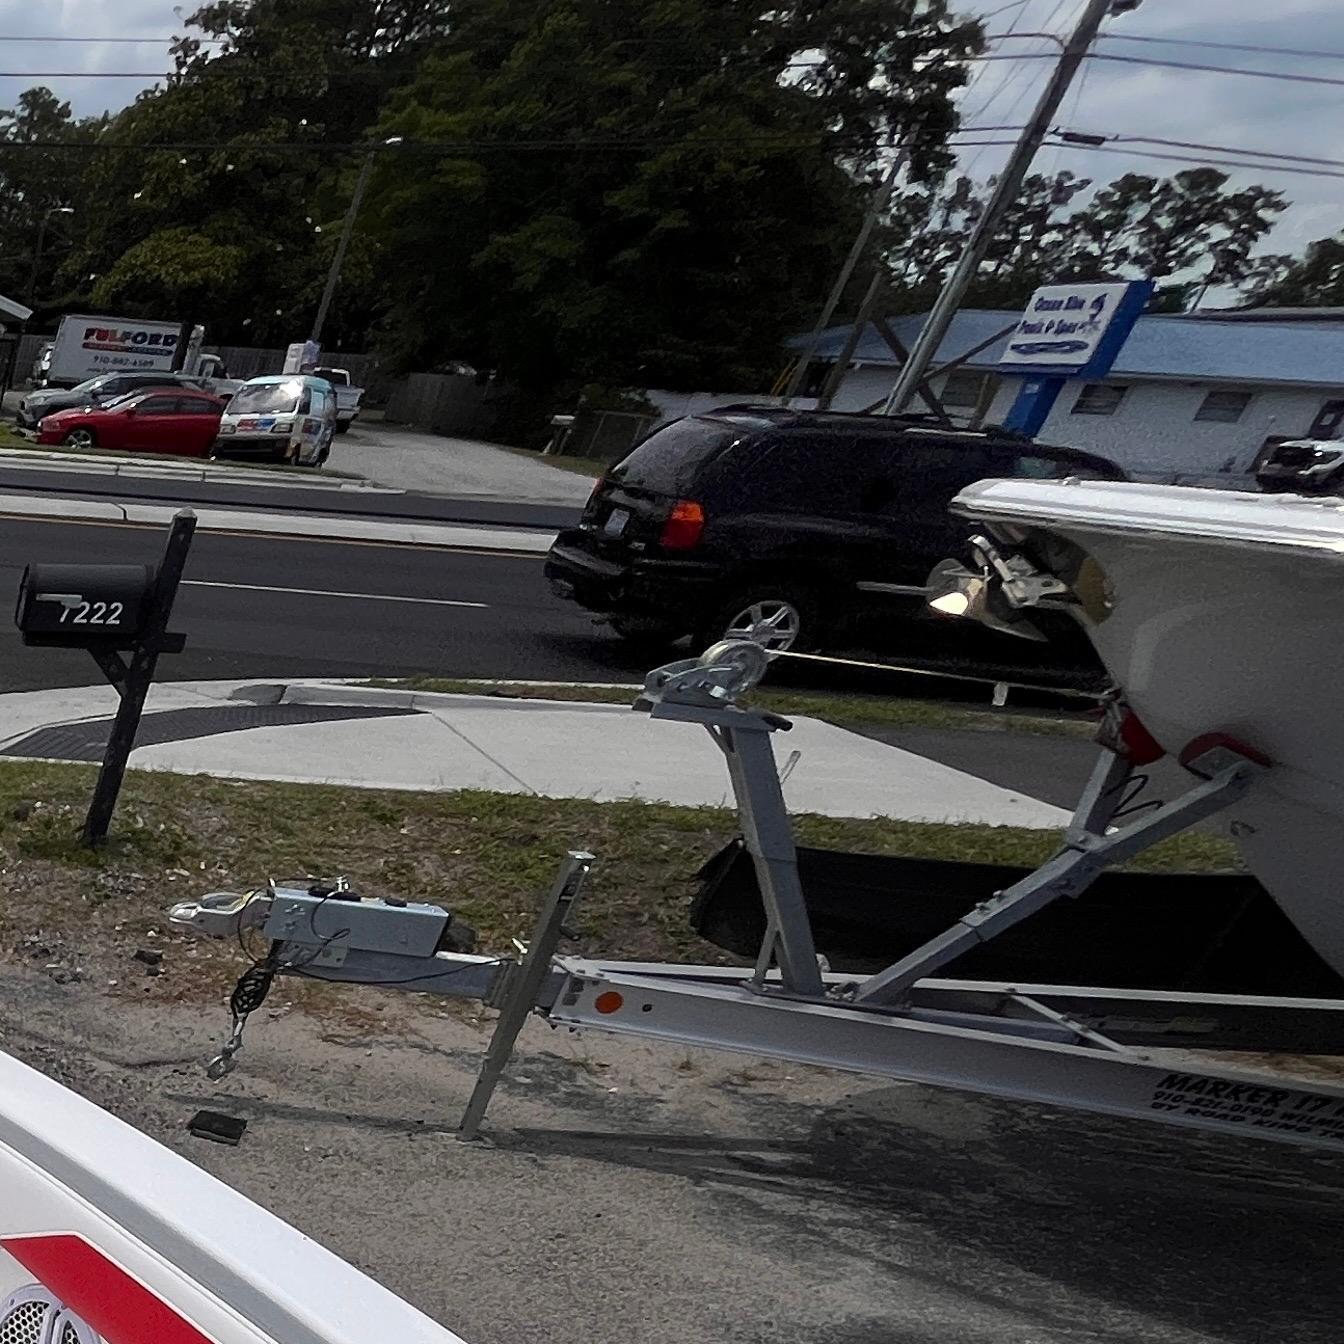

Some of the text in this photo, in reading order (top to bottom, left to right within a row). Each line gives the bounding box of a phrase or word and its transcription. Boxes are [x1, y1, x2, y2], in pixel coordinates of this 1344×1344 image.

[83, 327, 179, 346] FULFORD
[59, 601, 124, 625] 7222
[1156, 1074, 1290, 1108] MARKER
[1293, 1095, 1332, 1112] 17
[1151, 1101, 1181, 1112] BY
[1184, 1107, 1247, 1122] ROAD
[1251, 1118, 1312, 1133] KING
